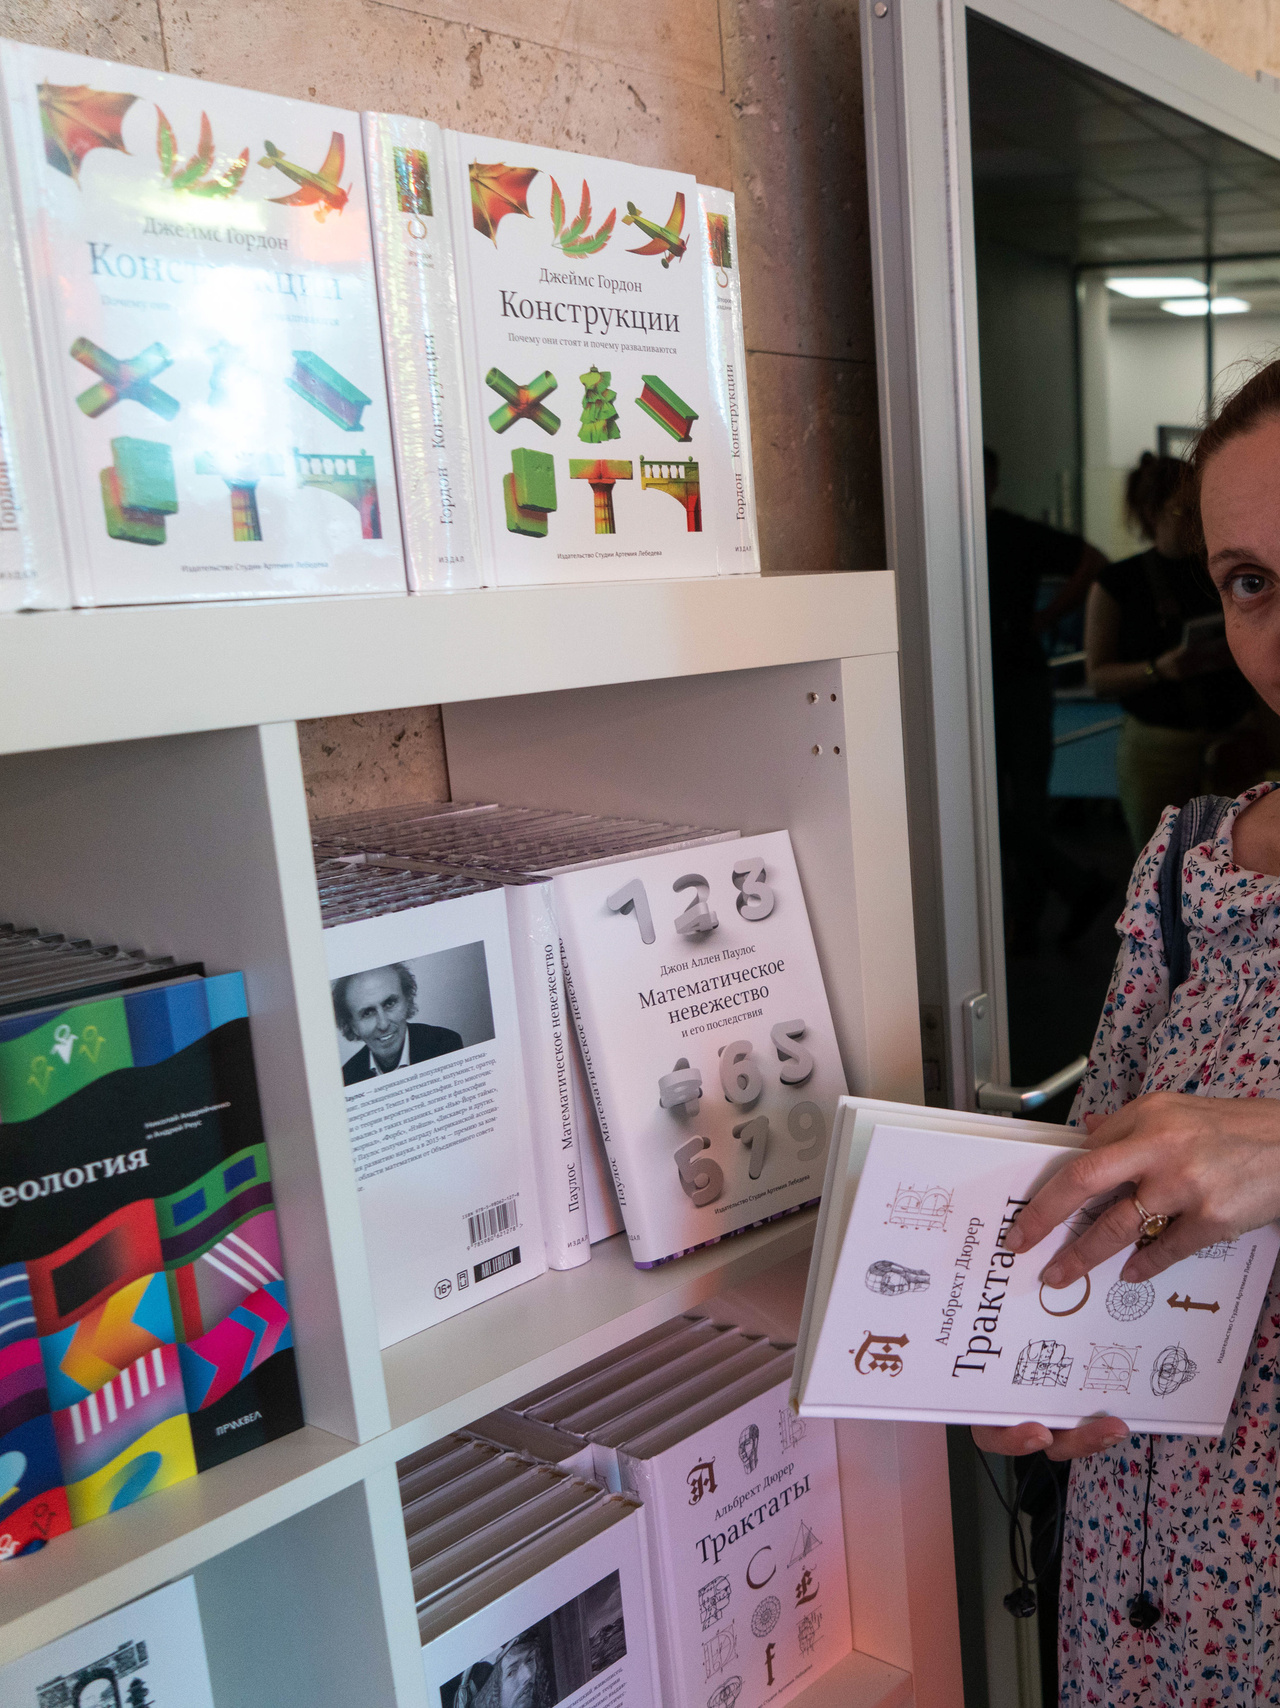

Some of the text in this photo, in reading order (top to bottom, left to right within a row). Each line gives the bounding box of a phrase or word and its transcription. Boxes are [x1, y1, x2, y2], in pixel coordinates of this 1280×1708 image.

[226, 225, 290, 251] Гордон
[539, 267, 642, 294] Джеймс Гордон
[499, 289, 681, 335] Конструкции
[508, 332, 677, 355] Почему они стоят и почему разваливаются
[727, 364, 746, 521] Гордон Конструкции
[438, 555, 464, 563] ИЗДАЛ
[557, 552, 594, 560] Издательство
[595, 551, 615, 559] Студии
[615, 551, 638, 559] Артемия
[660, 944, 756, 978] Джон Аллен Паулос
[638, 959, 786, 1010] Математическое
[668, 985, 770, 1024] невежество
[681, 1008, 764, 1038] и его последствия
[544, 944, 581, 1214] Паулос Математическое невежество
[578, 1024, 612, 1142] Математическое
[144, 1114, 180, 1129] Николай
[0, 1148, 150, 1208] еология
[714, 1173, 811, 1215] Издательство Студии Артемия Лебедева
[567, 1233, 589, 1248] ИЗДАЛ
[437, 1284, 452, 1296] 16+
[935, 1216, 985, 1346] Альбрехт Дюрер
[1217, 1244, 1258, 1364] Издательство Студии Артемия Лебедева
[714, 1461, 795, 1521] Альбрехт Дюрер
[695, 1473, 812, 1566] Трактаты
